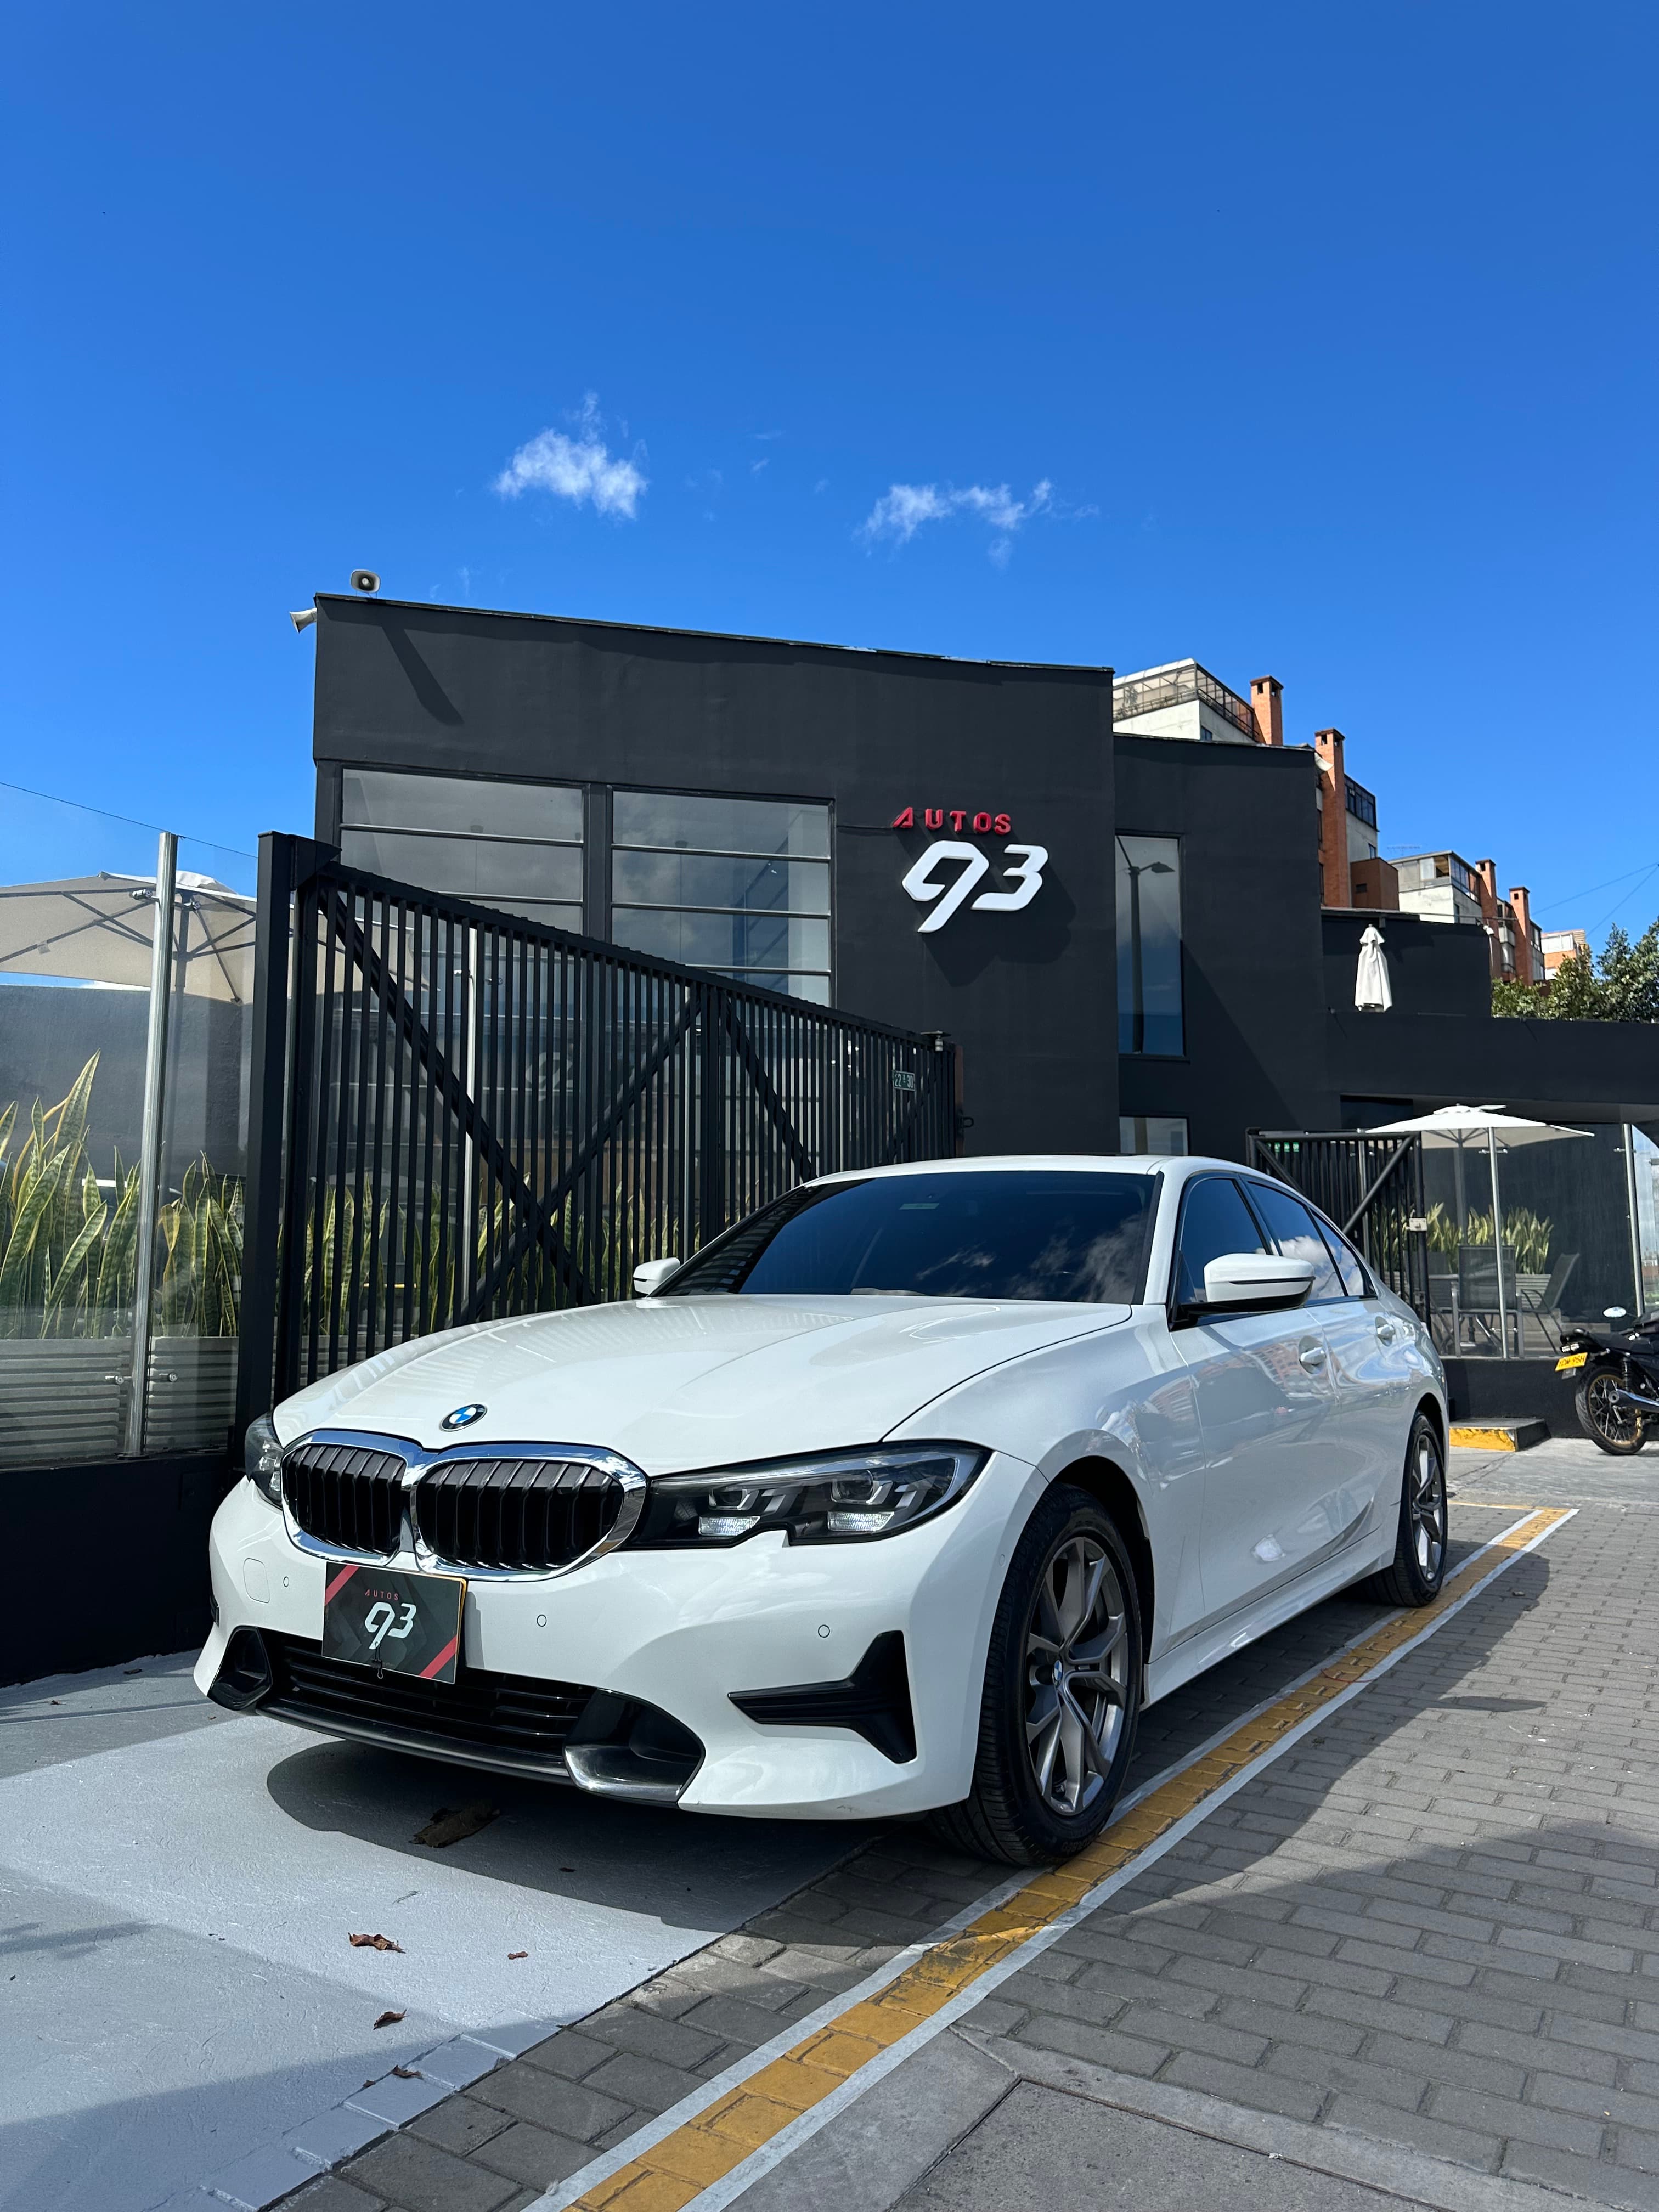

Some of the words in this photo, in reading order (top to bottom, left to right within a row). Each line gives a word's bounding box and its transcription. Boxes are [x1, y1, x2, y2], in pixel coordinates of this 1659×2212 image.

[891, 806, 1011, 835] AUTOS
[901, 840, 1049, 933] 93
[365, 1589, 399, 1601] AUTOS
[364, 1601, 417, 1650] 93
